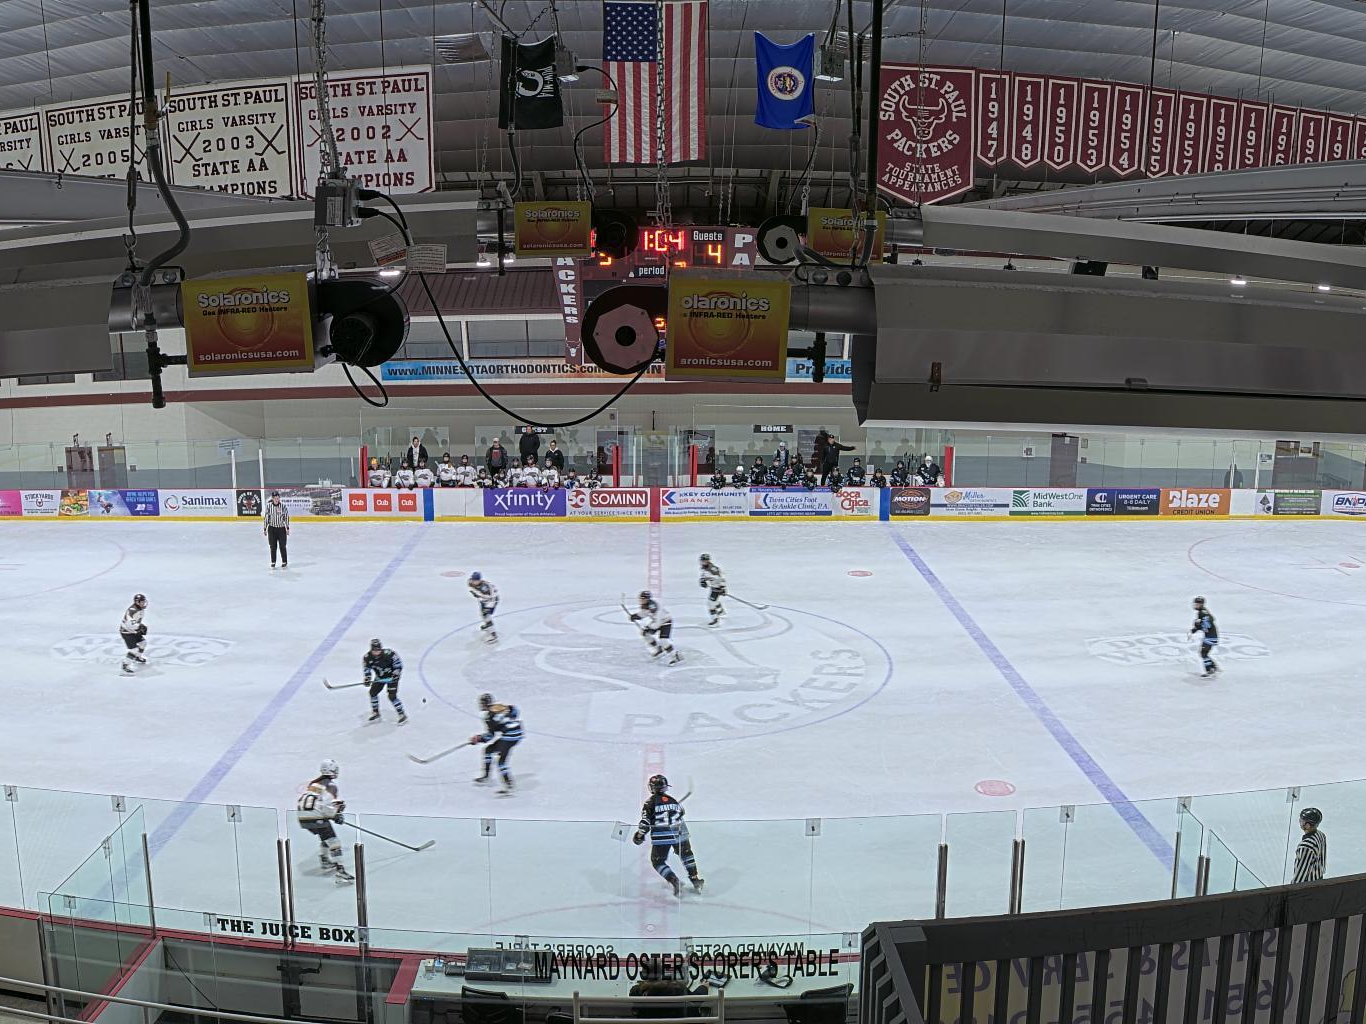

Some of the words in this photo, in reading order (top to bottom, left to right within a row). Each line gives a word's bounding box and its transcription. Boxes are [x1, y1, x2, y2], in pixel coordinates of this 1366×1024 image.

[381, 78, 425, 94] PAUL
[168, 95, 218, 113] SOUTH
[244, 89, 284, 105] PAUL
[879, 75, 915, 121] SOUTH
[940, 81, 967, 122] PAUL
[48, 108, 96, 127] SOUTH
[358, 103, 416, 117] VARSITY
[987, 81, 999, 158] 1947
[4, 119, 37, 135] PAUL
[177, 119, 214, 133] GIRLS
[222, 112, 276, 128] VARSITY
[1021, 84, 1034, 161] 1948
[1053, 87, 1067, 163] 1950
[1086, 91, 1100, 166] 1953
[1119, 94, 1132, 169] 1954
[57, 132, 91, 146] GIRLS
[335, 125, 391, 142] 2002
[1150, 99, 1164, 172] 1955
[1244, 112, 1256, 168] 195
[202, 135, 255, 153] 2003
[886, 129, 960, 158] PACKERS
[82, 149, 130, 167] 2005
[385, 148, 408, 163] AA
[192, 160, 240, 177] STATE
[247, 158, 269, 172] AA
[525, 207, 580, 218] Solaronics
[693, 230, 723, 241] Guests
[708, 244, 722, 264] 4
[639, 265, 665, 277] period
[197, 285, 291, 308] Solaronics
[556, 257, 579, 324] ACKERS
[199, 350, 299, 361] solaronicsusa.com
[182, 496, 228, 506] Sanimax
[494, 490, 555, 511] xfinity
[592, 493, 646, 505] SOMINN
[1033, 492, 1084, 500] MidWestOne
[1168, 490, 1220, 508] Blaze
[620, 648, 866, 736] PACKERS
[217, 917, 254, 934] THE
[319, 927, 356, 943] BOX
[534, 951, 621, 980] MAYNARD
[625, 952, 685, 980] OSTER
[688, 951, 778, 980] SCORER'S
[784, 949, 840, 977] TABLE
